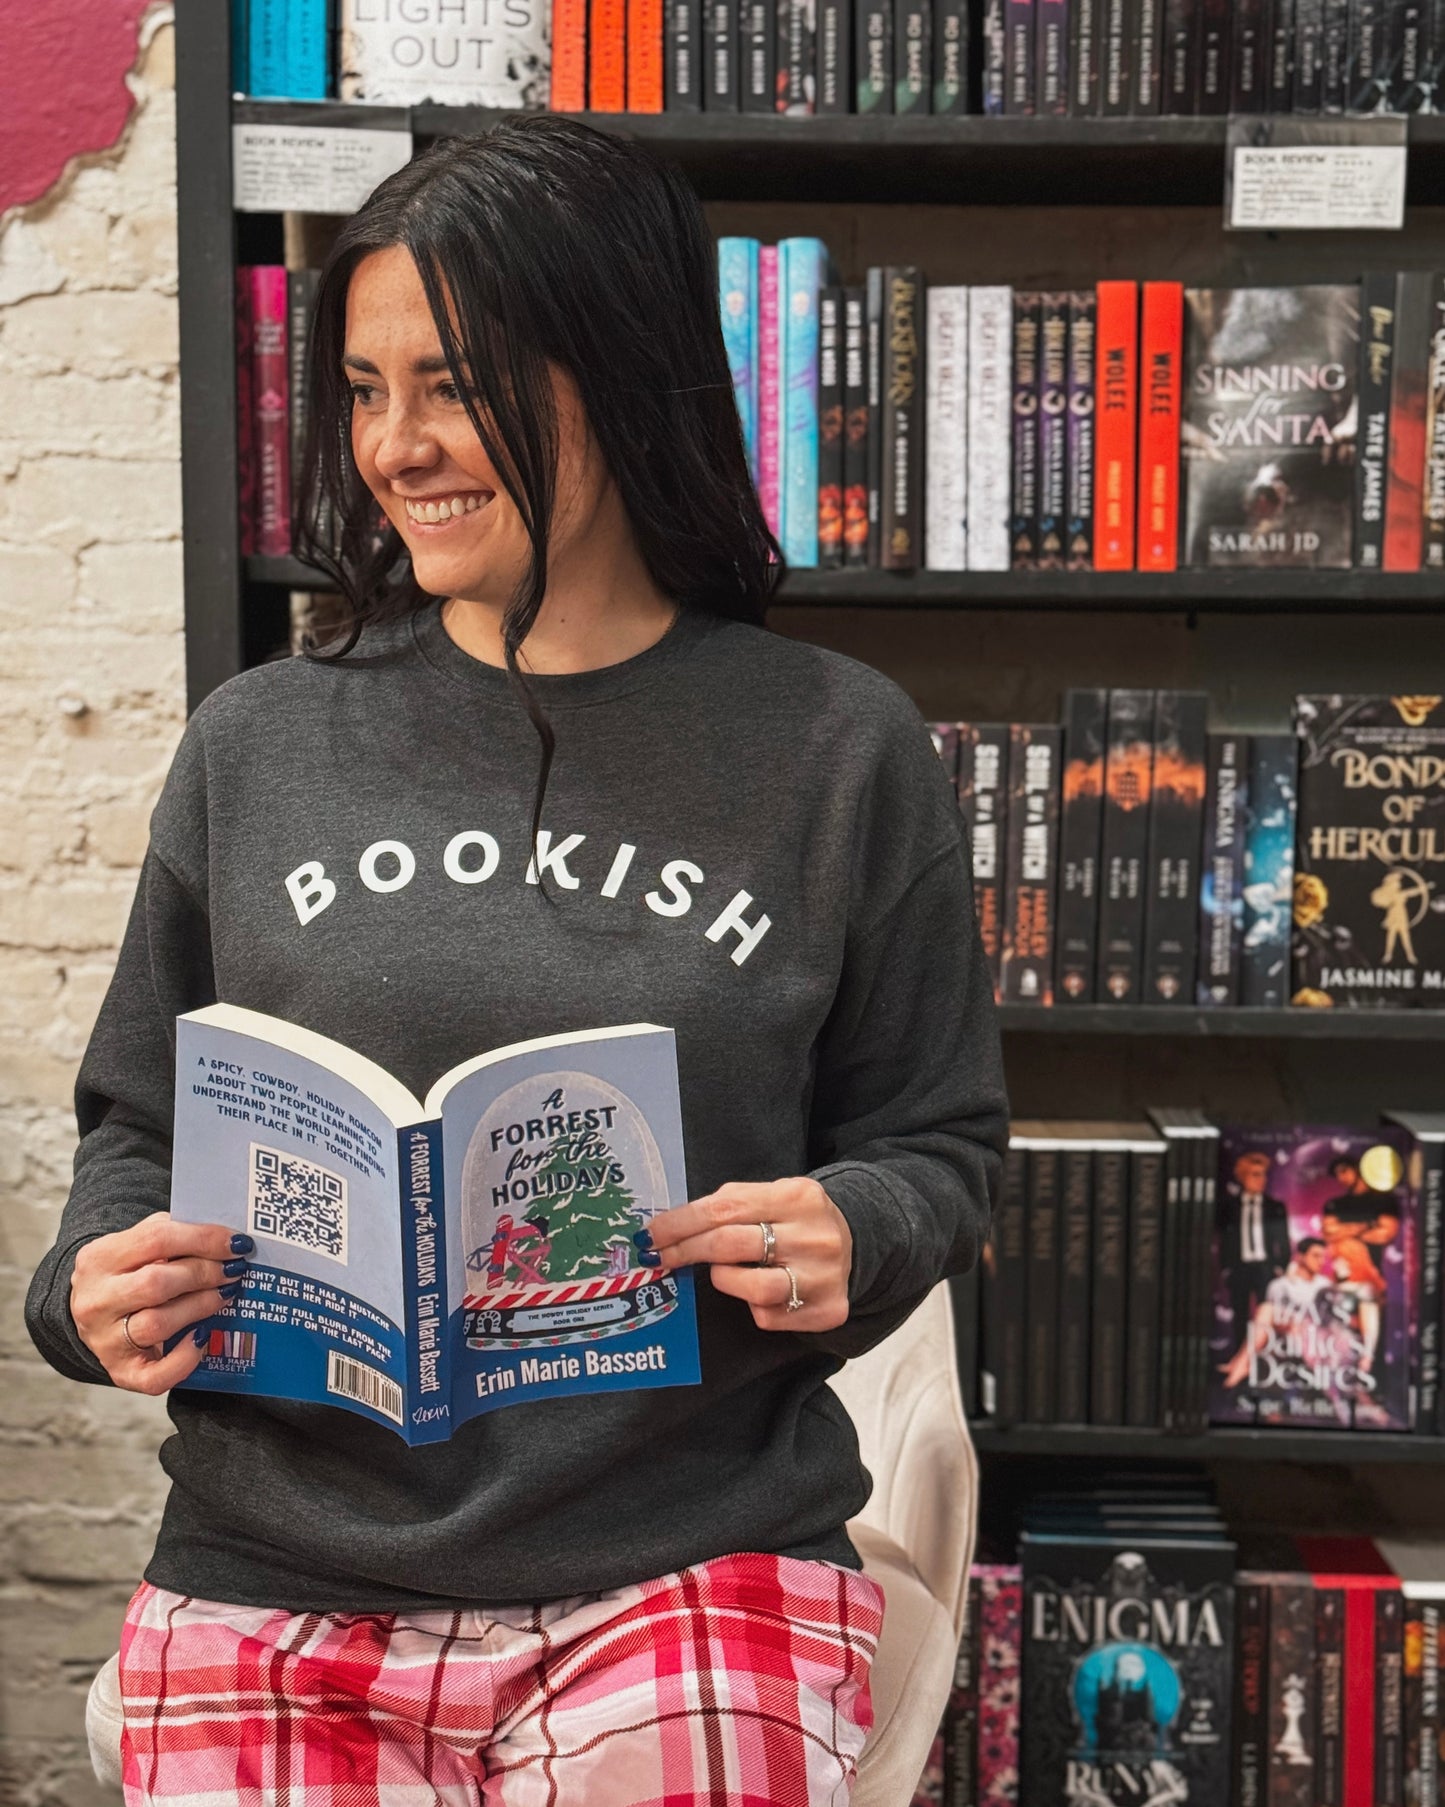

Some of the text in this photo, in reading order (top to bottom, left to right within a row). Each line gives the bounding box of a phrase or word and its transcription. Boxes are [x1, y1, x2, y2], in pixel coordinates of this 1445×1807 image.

[354, 0, 531, 27] LIGHTS
[391, 36, 493, 71] OUT
[1195, 363, 1346, 393] SINNING
[1207, 412, 1334, 446] SANTA
[1361, 413, 1386, 522] TATE JAMES
[1210, 532, 1319, 553] SARAH JD
[1024, 745, 1051, 793] SOUL
[1216, 769, 1236, 847] ENIGMA
[1383, 795, 1426, 823] OF
[1022, 825, 1048, 880] WITCH
[284, 829, 772, 967] BOOKISH
[1033, 888, 1048, 957] HARLEY
[1320, 967, 1415, 988] JASMINE
[198, 1057, 206, 1066] A
[306, 1091, 345, 1118] HOLIDAY
[350, 1114, 383, 1149] ROMCOM
[207, 1073, 377, 1156] ABOUT TWO PEOPLE LEARNING TO
[542, 1088, 566, 1112] A
[193, 1085, 386, 1178] UNDERSTAND THE WORLD AND FINDING
[217, 1104, 250, 1122] THEIR
[255, 1114, 288, 1133] PLACE
[292, 1126, 304, 1140] IN
[324, 1141, 371, 1178] TOGETHER
[490, 1106, 618, 1153] FORREST
[505, 1132, 613, 1181] for the
[409, 1131, 437, 1286] A FORREST for the HOLIDAYS
[491, 1162, 627, 1208] HOLIDAYS
[241, 1280, 256, 1289] ND
[260, 1282, 273, 1292] HE
[277, 1285, 299, 1298] LETS
[303, 1292, 322, 1304] HER
[325, 1299, 345, 1314] RIDE
[242, 1270, 391, 1332] IGHT? BUT HE HAS A MUSTACHE
[541, 1310, 564, 1319] HOWDY
[566, 1307, 591, 1316] HOLIDAY
[593, 1303, 614, 1312] SERIES
[237, 1299, 392, 1359] HEAR THE FULL BLURB FROM THE
[241, 1309, 256, 1319] OR
[260, 1312, 287, 1324] READ
[291, 1316, 300, 1327] IT
[304, 1318, 318, 1331] ON
[322, 1325, 340, 1339] THE
[342, 1333, 363, 1351] LAST
[418, 1294, 440, 1394] Erin Marie Bassett
[208, 1363, 247, 1373] BASSETT
[228, 1358, 256, 1368] MARIE
[475, 1345, 667, 1398] Erin Marie Bassett
[1032, 1593, 1223, 1647] ENIGMA
